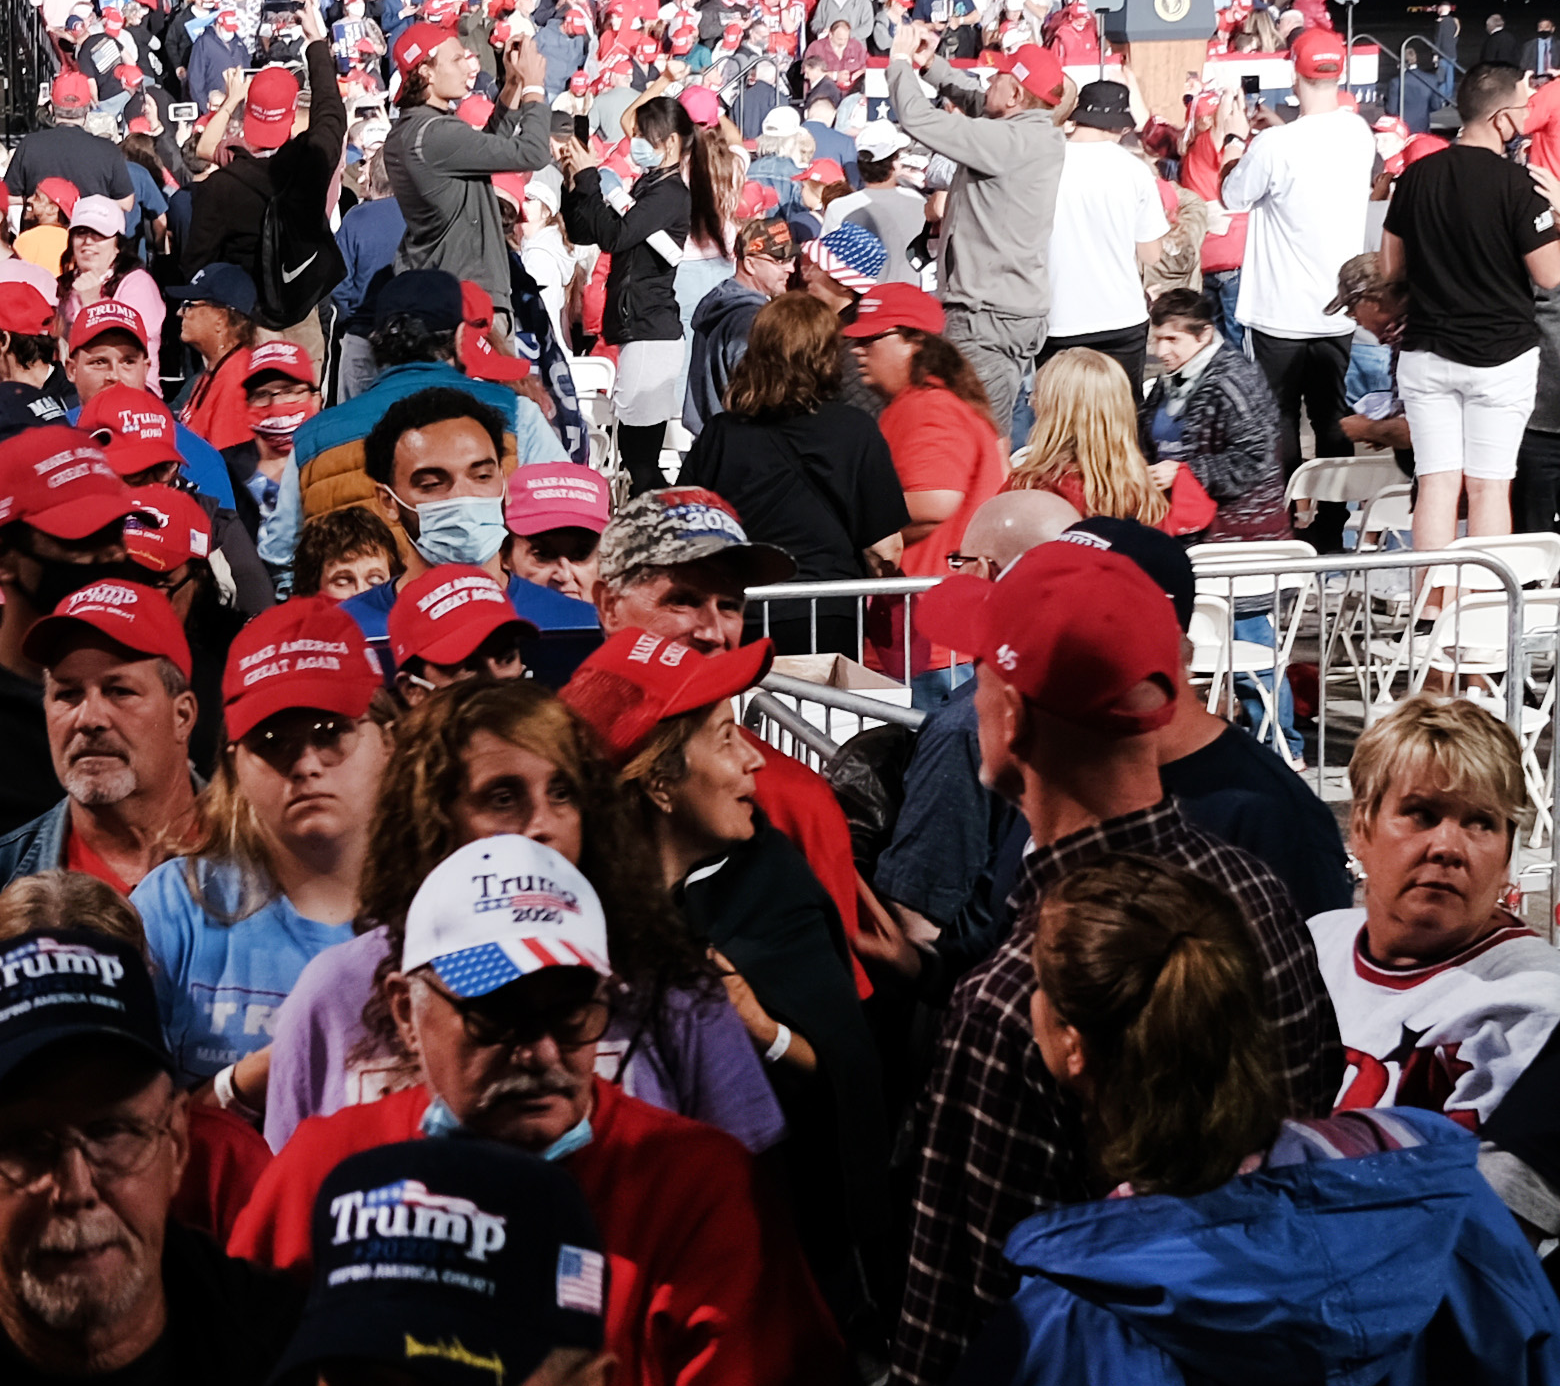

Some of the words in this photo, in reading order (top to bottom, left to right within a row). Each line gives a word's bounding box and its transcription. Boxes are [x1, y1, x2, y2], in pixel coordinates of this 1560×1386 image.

[118, 409, 167, 429] Trump
[239, 644, 277, 671] MAKE
[277, 638, 350, 656] AMERICA
[994, 643, 1020, 671] 45
[243, 659, 291, 687] GREAT
[295, 657, 341, 671] AGAIN
[472, 873, 578, 909] Trump
[329, 1190, 507, 1263] Trump
[372, 1261, 440, 1286] AMERICA
